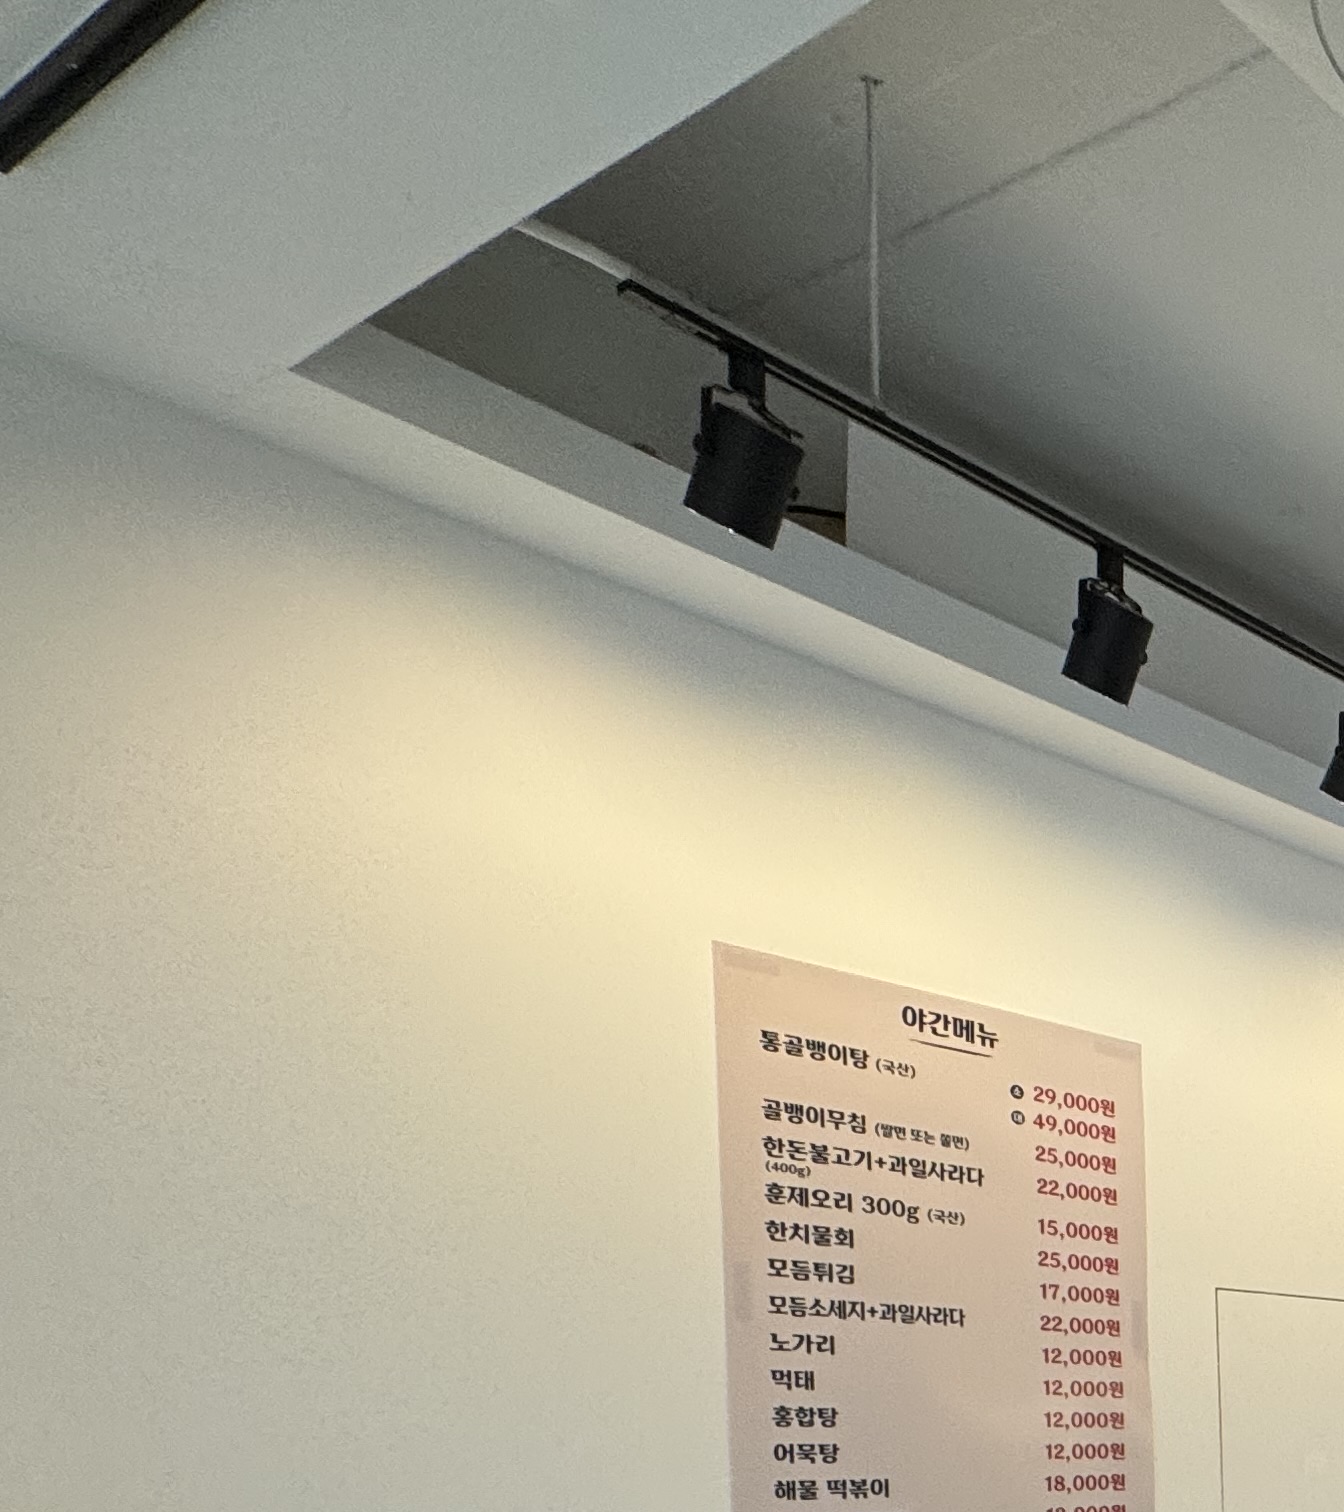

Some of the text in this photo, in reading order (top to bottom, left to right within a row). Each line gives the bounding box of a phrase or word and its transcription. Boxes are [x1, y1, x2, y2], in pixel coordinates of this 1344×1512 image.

[901, 1005, 999, 1049] 야간메뉴
[759, 1029, 916, 1079] 통골뱅이탕 (국산)
[1033, 1086, 1116, 1118] 29,000원
[761, 1098, 866, 1135] 골뱅이무침
[910, 1128, 936, 1145] 또는
[1033, 1114, 1117, 1144] 49,000원
[761, 1135, 984, 1187] 한돈불고기+과일사라다
[765, 1160, 811, 1178] (400g)
[1035, 1145, 1117, 1175] 25,000원
[764, 1182, 966, 1226] 훈제오리 300g (국산)
[1036, 1178, 1118, 1207] 22,000원
[764, 1219, 854, 1249] 한치물회
[1038, 1219, 1119, 1245] 15,000원
[767, 1258, 855, 1285] 모듬튀김
[1038, 1250, 1119, 1275] 25,000원
[1039, 1283, 1120, 1307] 17,000원
[767, 1295, 966, 1328] 모듬소세지+과일사라다
[1039, 1315, 1121, 1338] 22,000원
[769, 1332, 835, 1356] 노가리
[1042, 1347, 1123, 1368] 12,000원
[770, 1368, 815, 1391] 먹태
[1043, 1379, 1124, 1400] 12,000원
[772, 1405, 838, 1428] 홍합탕
[1044, 1410, 1125, 1431] 12,000원
[773, 1442, 839, 1464] 어묵탕
[1045, 1442, 1126, 1462] 12,000원
[774, 1477, 890, 1501] 해물 떡볶이
[1044, 1473, 1126, 1494] 18,000원
